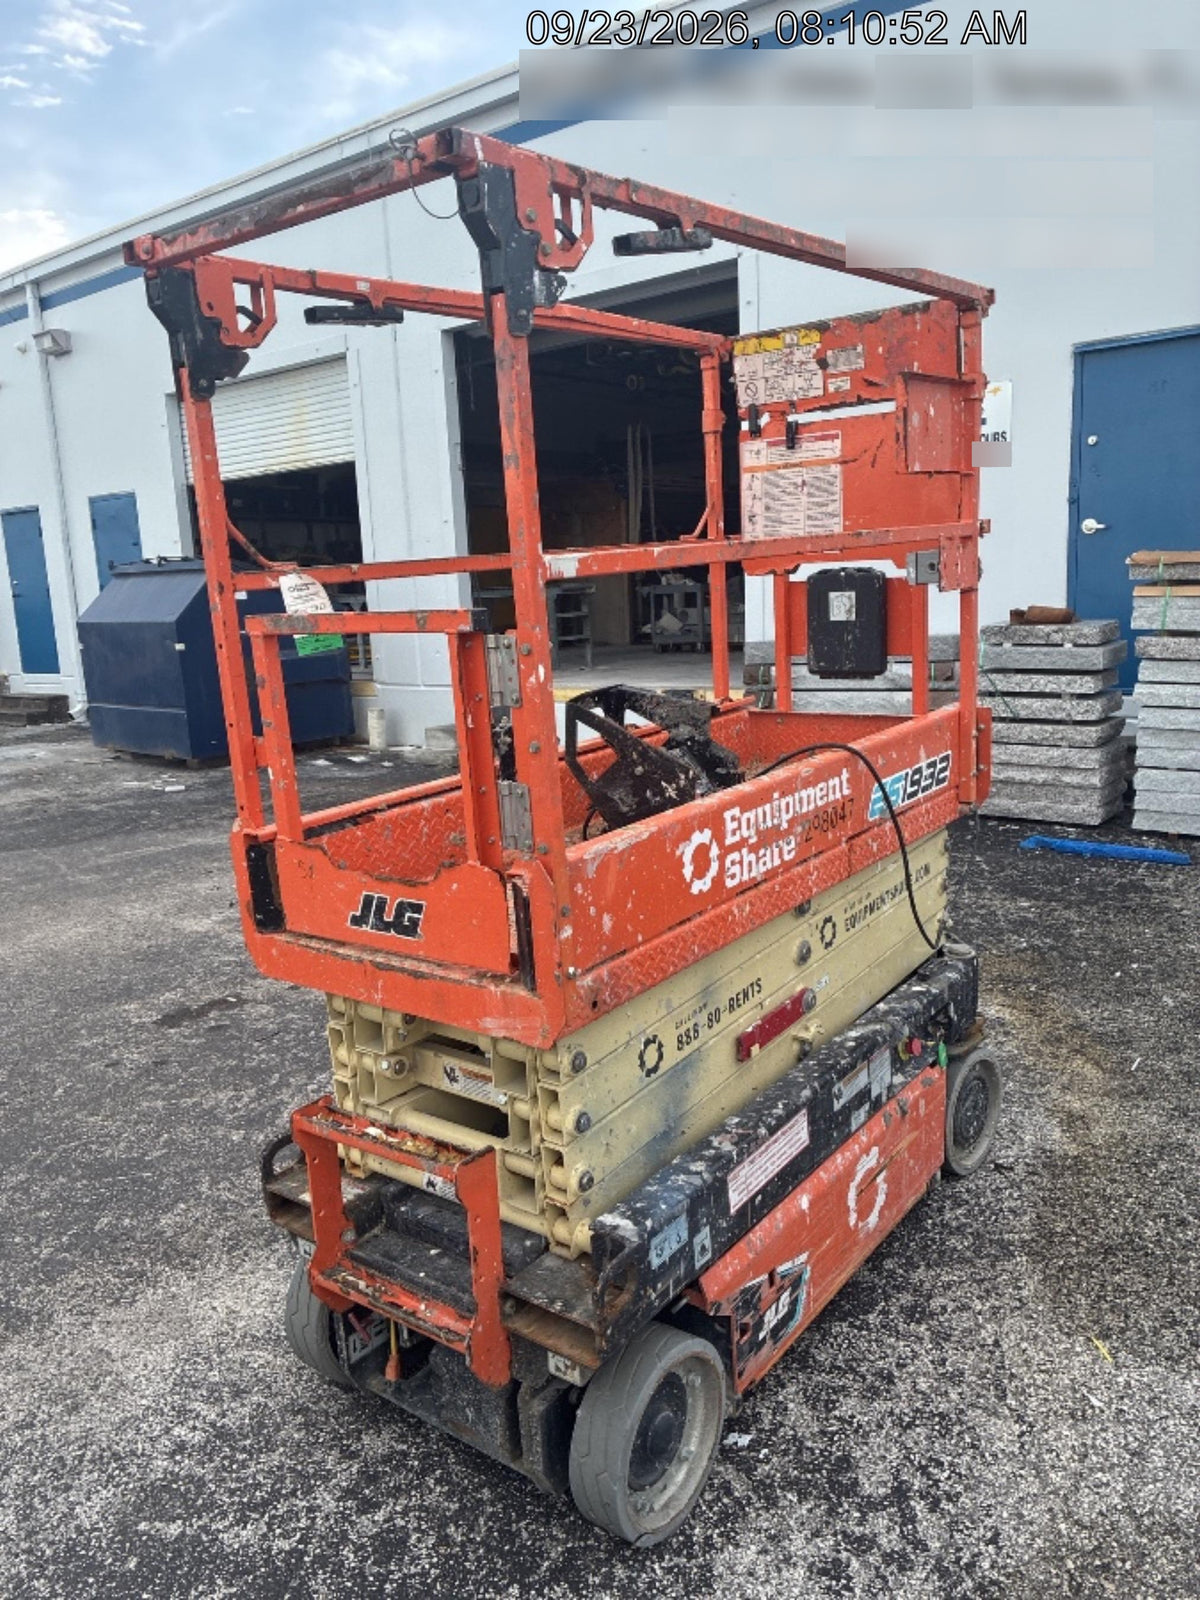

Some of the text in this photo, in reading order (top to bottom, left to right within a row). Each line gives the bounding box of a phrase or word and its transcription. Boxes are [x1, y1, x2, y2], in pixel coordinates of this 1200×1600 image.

[723, 768, 853, 845] Equipment
[868, 750, 952, 821] ES1932
[724, 835, 797, 890] Share
[347, 891, 426, 941] JLG
[676, 977, 762, 1051] 888-80-RENTS
[758, 1287, 792, 1341] JLG
